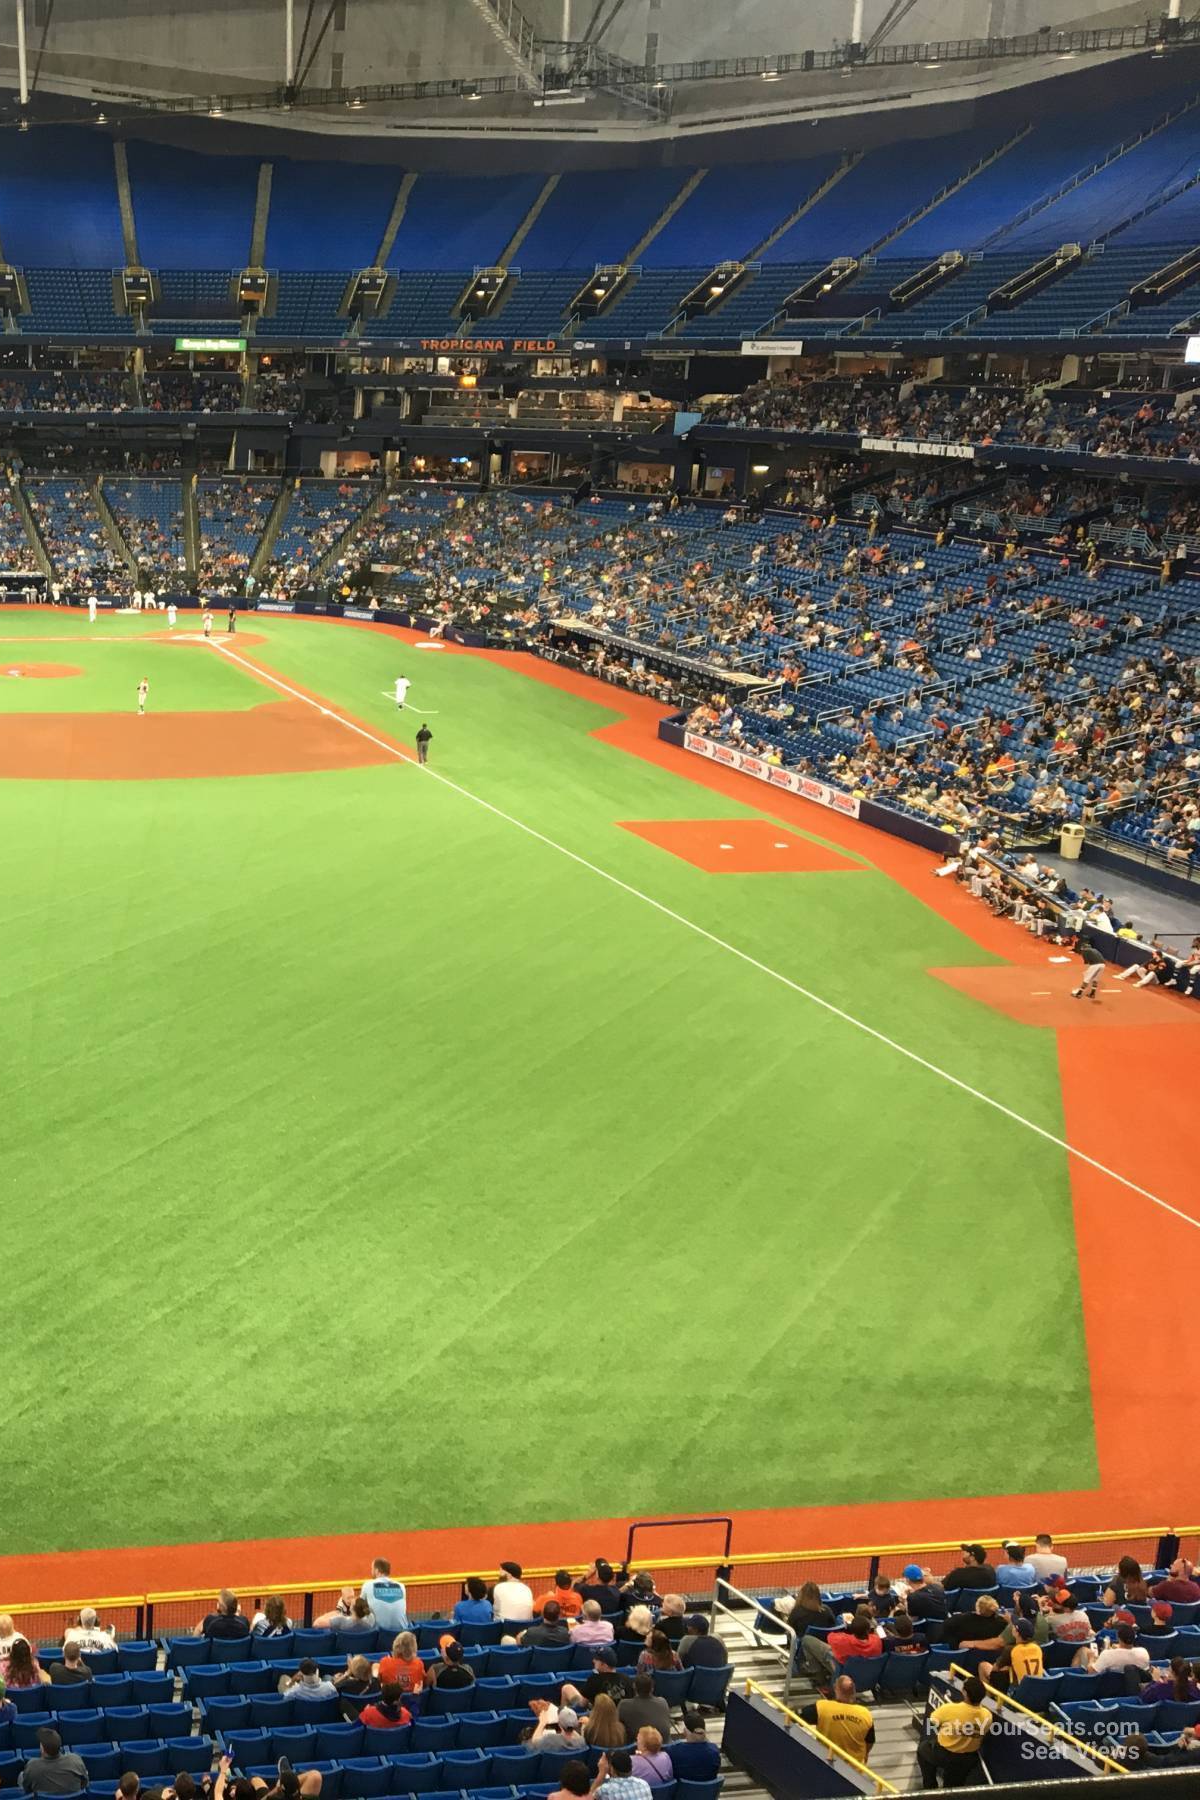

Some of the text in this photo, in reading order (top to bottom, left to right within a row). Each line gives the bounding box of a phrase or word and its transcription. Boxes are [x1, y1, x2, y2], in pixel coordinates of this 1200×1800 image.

[420, 339, 504, 350] TROPICANA
[513, 340, 556, 351] FIELD
[1023, 1658, 1040, 1676] 17
